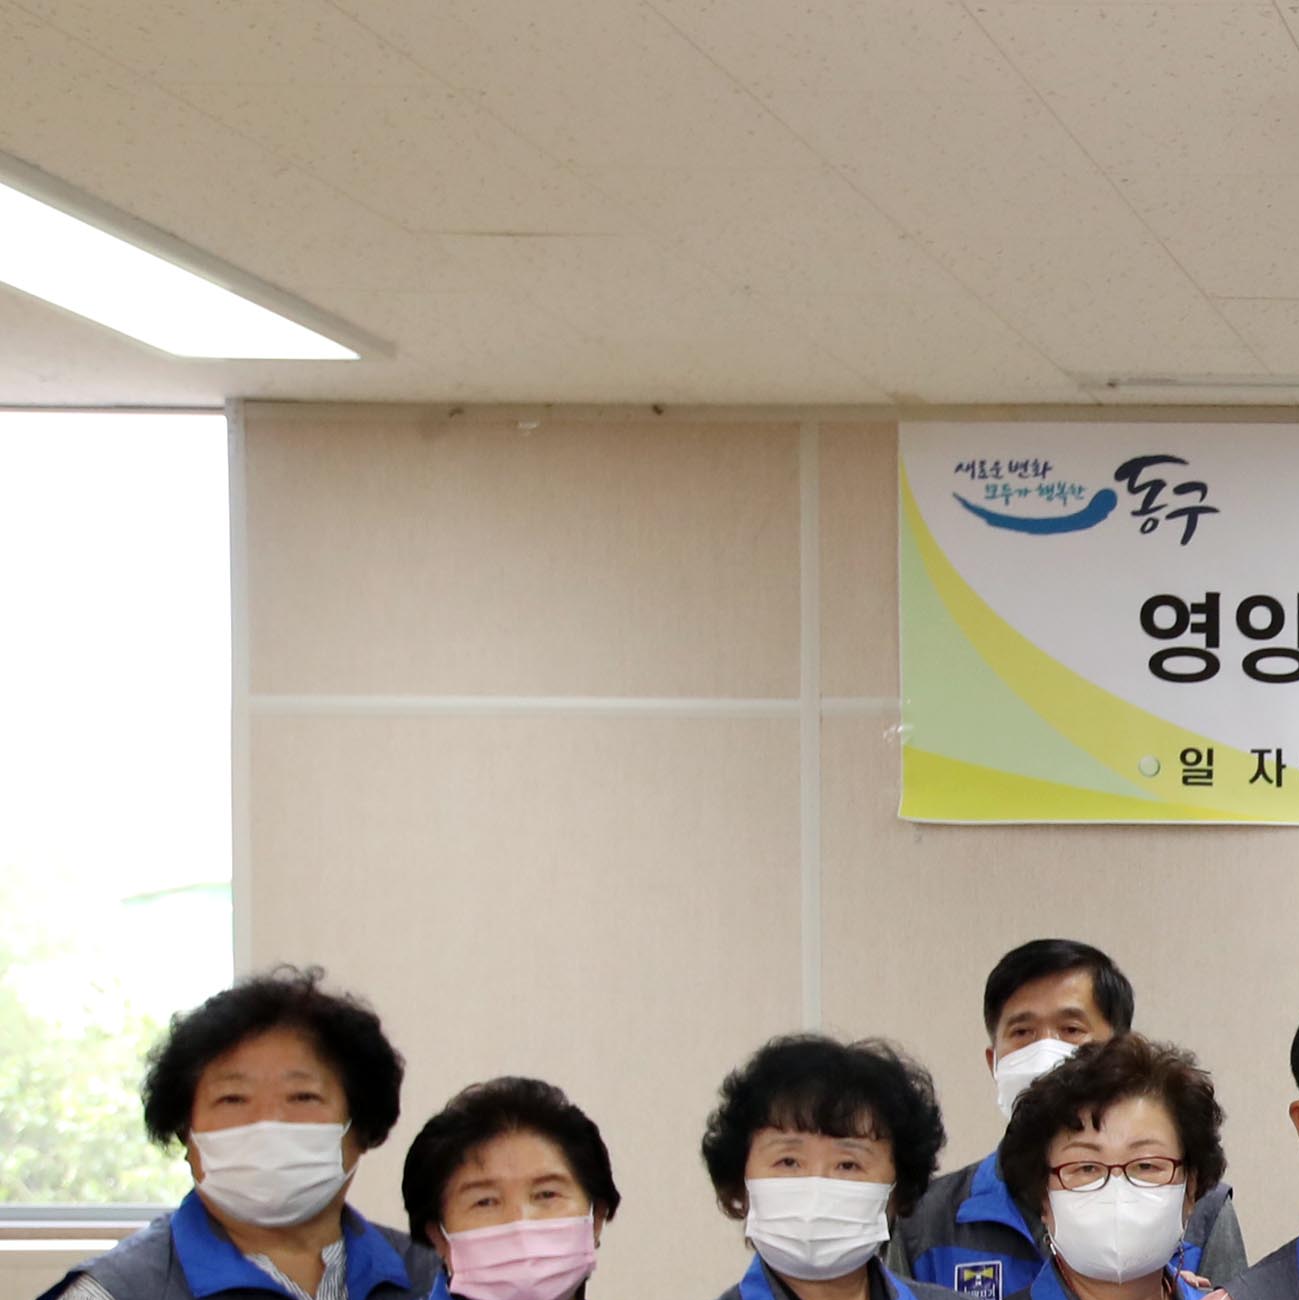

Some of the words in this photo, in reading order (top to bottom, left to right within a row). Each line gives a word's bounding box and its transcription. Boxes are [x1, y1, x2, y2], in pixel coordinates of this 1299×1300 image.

[954, 459, 1004, 480] 새로운
[1009, 459, 1052, 480] 변화
[984, 483, 1031, 506] 모두가
[1037, 481, 1087, 506] 행복한
[1114, 454, 1220, 546] 동구
